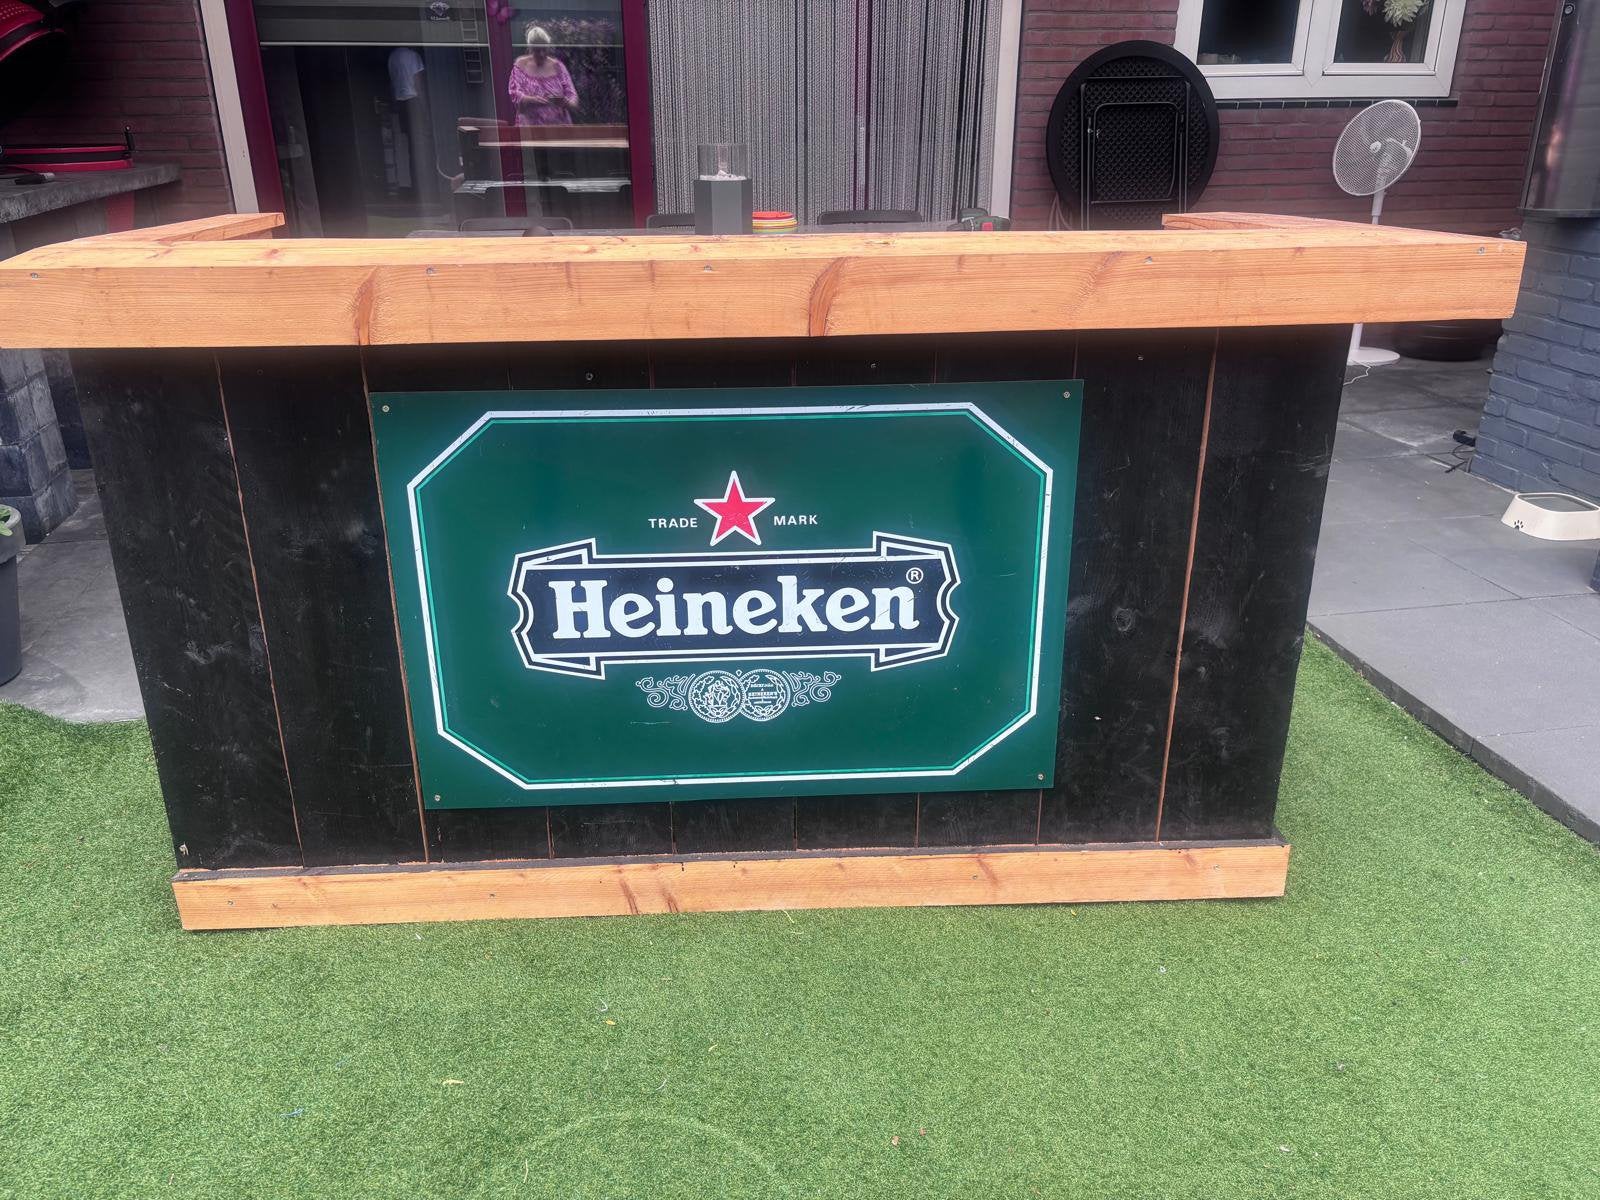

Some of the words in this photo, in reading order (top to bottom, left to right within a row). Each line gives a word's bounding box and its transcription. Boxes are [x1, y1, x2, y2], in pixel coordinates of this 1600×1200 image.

[648, 517, 698, 529] TRADE
[773, 514, 819, 526] MARK
[548, 575, 920, 640] Heineken
